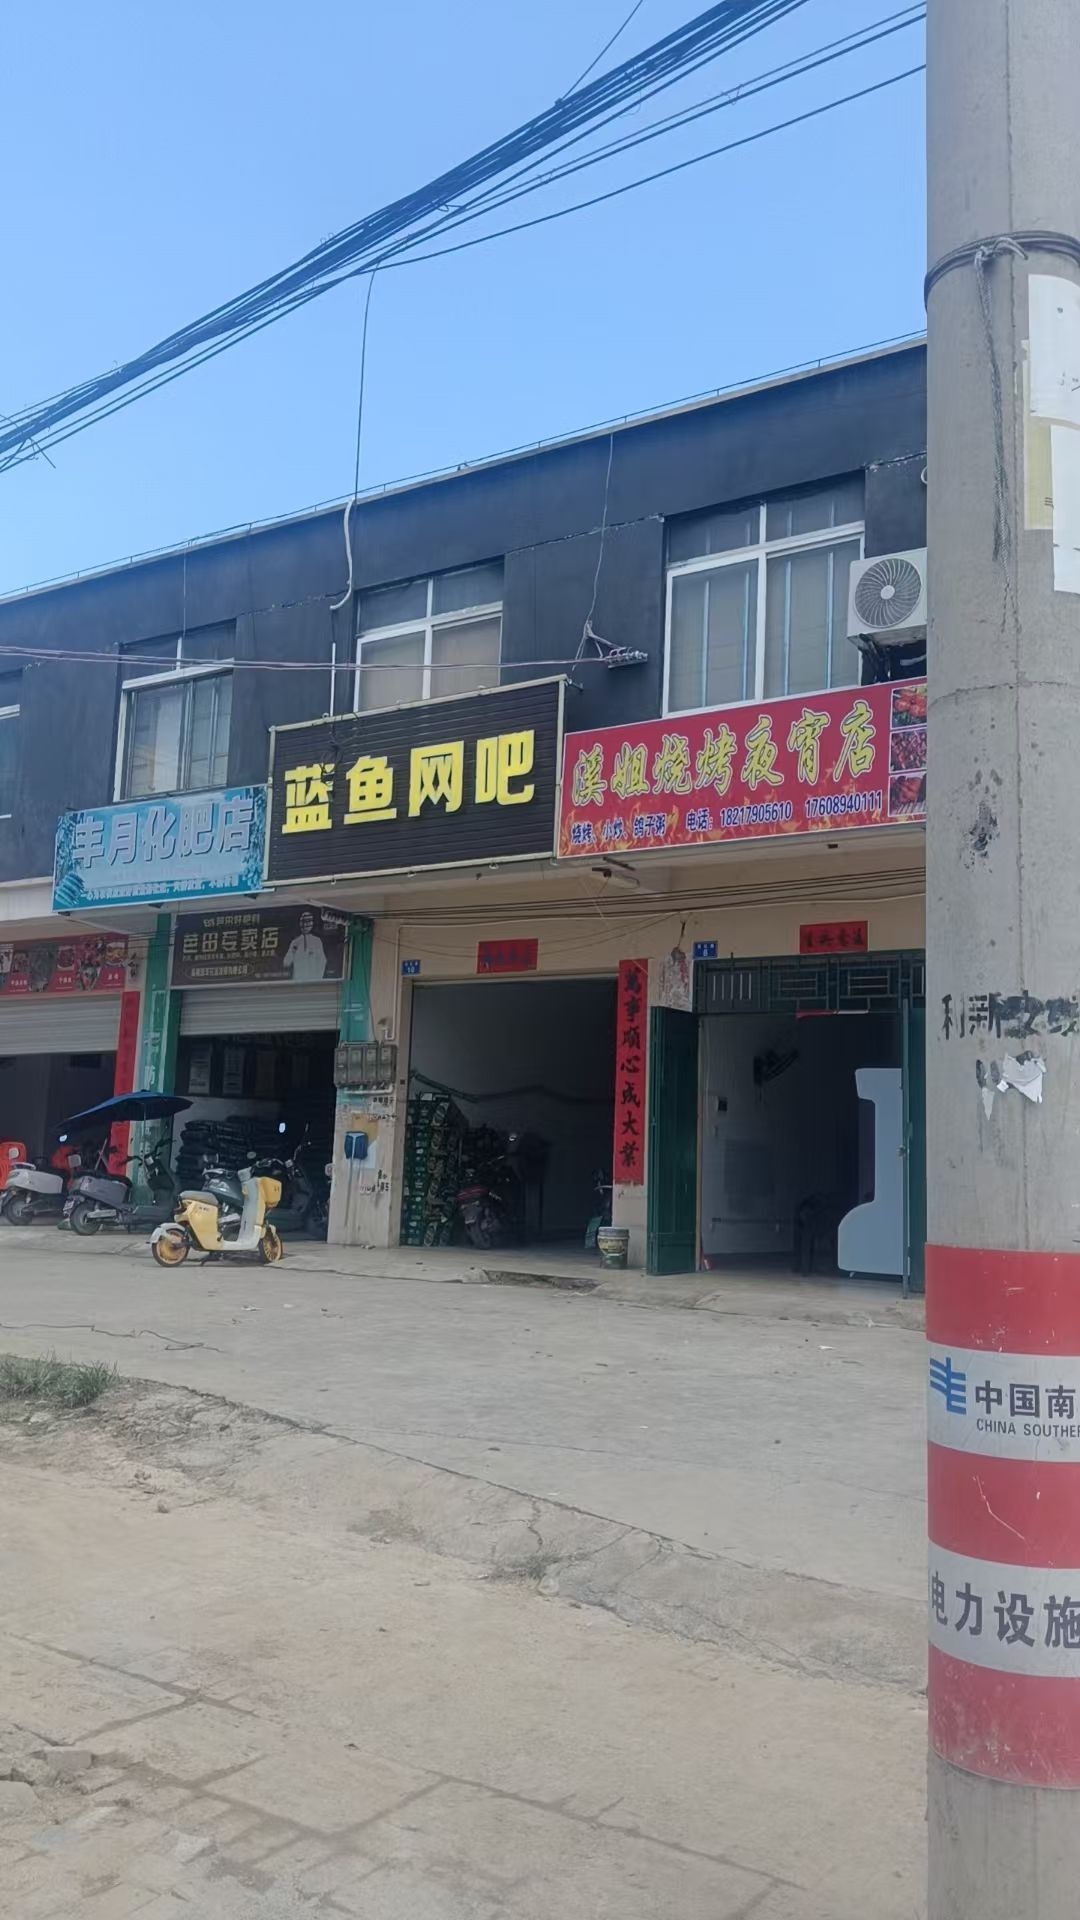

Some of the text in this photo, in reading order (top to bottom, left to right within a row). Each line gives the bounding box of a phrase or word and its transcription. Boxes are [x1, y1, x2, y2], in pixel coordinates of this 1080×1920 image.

[281, 729, 536, 834] 蓝鱼网吧
[720, 801, 793, 827] 18217905610
[804, 790, 883, 818] 17608940111
[975, 1379, 1076, 1419] 中国南
[976, 1417, 1017, 1435] CHINA
[930, 1571, 1080, 1649] 电力设施
